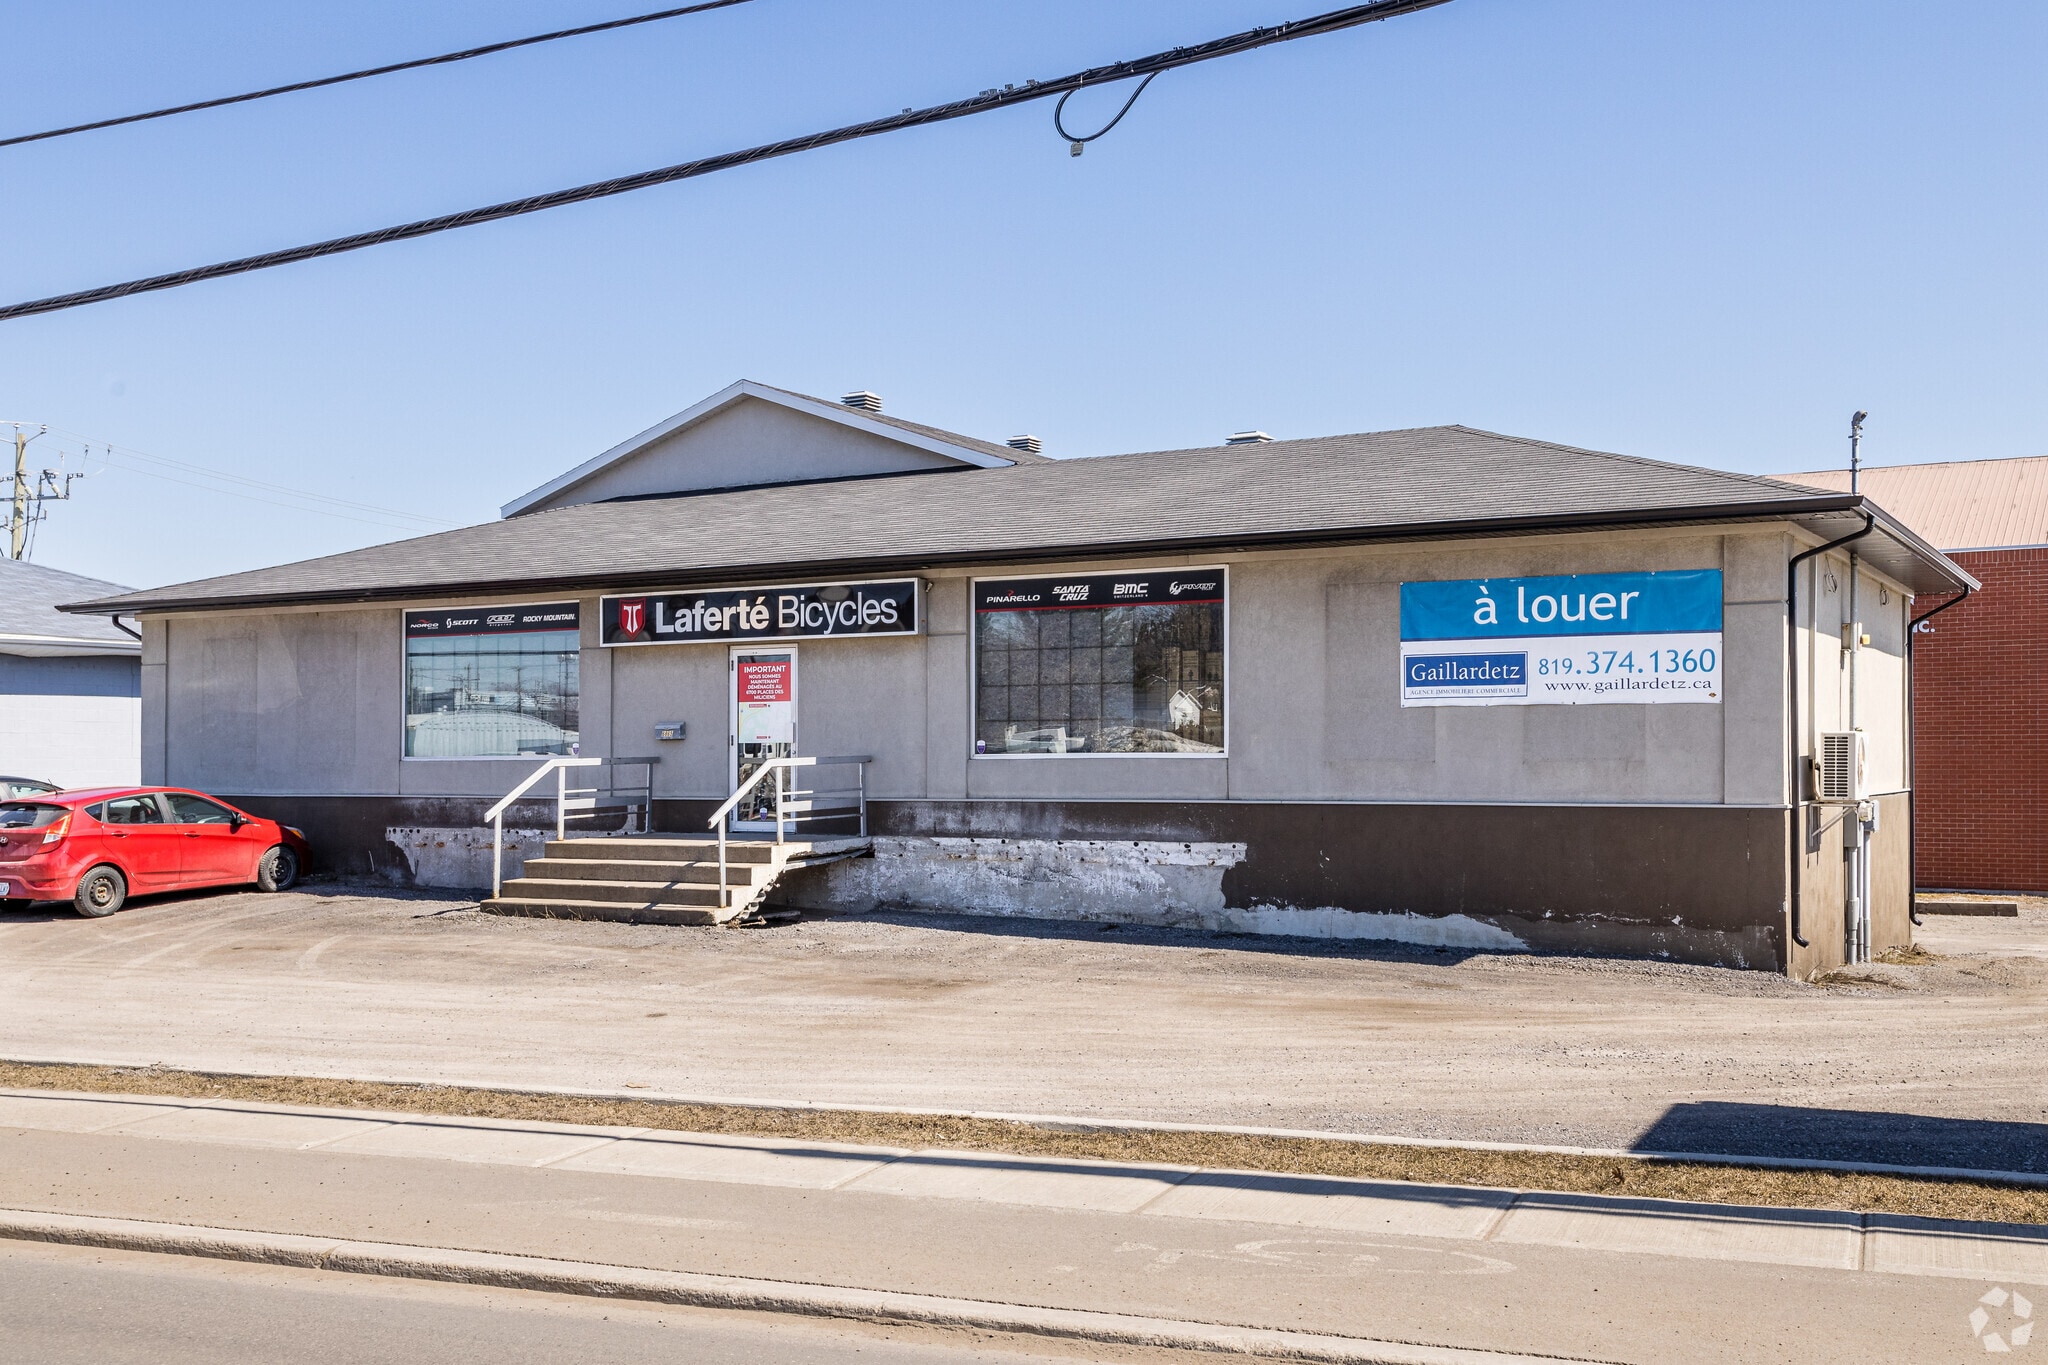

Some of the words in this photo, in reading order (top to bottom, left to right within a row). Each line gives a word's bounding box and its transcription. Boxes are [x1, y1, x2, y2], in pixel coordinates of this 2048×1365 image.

[1051, 585, 1090, 594] SANTA
[1113, 583, 1149, 595] BMC
[986, 594, 1041, 604] PINARELLO
[1059, 592, 1089, 601] CRUZ
[1473, 585, 1498, 625] à
[1517, 586, 1640, 623] louer
[655, 597, 769, 633] Laferté
[778, 591, 898, 635] Bicycles
[523, 615, 543, 623] ROCKY
[744, 665, 786, 673] IMPORTANT
[1411, 661, 1521, 681] Gaillardetz
[1545, 678, 1712, 693] www.gaillardetz.ca
